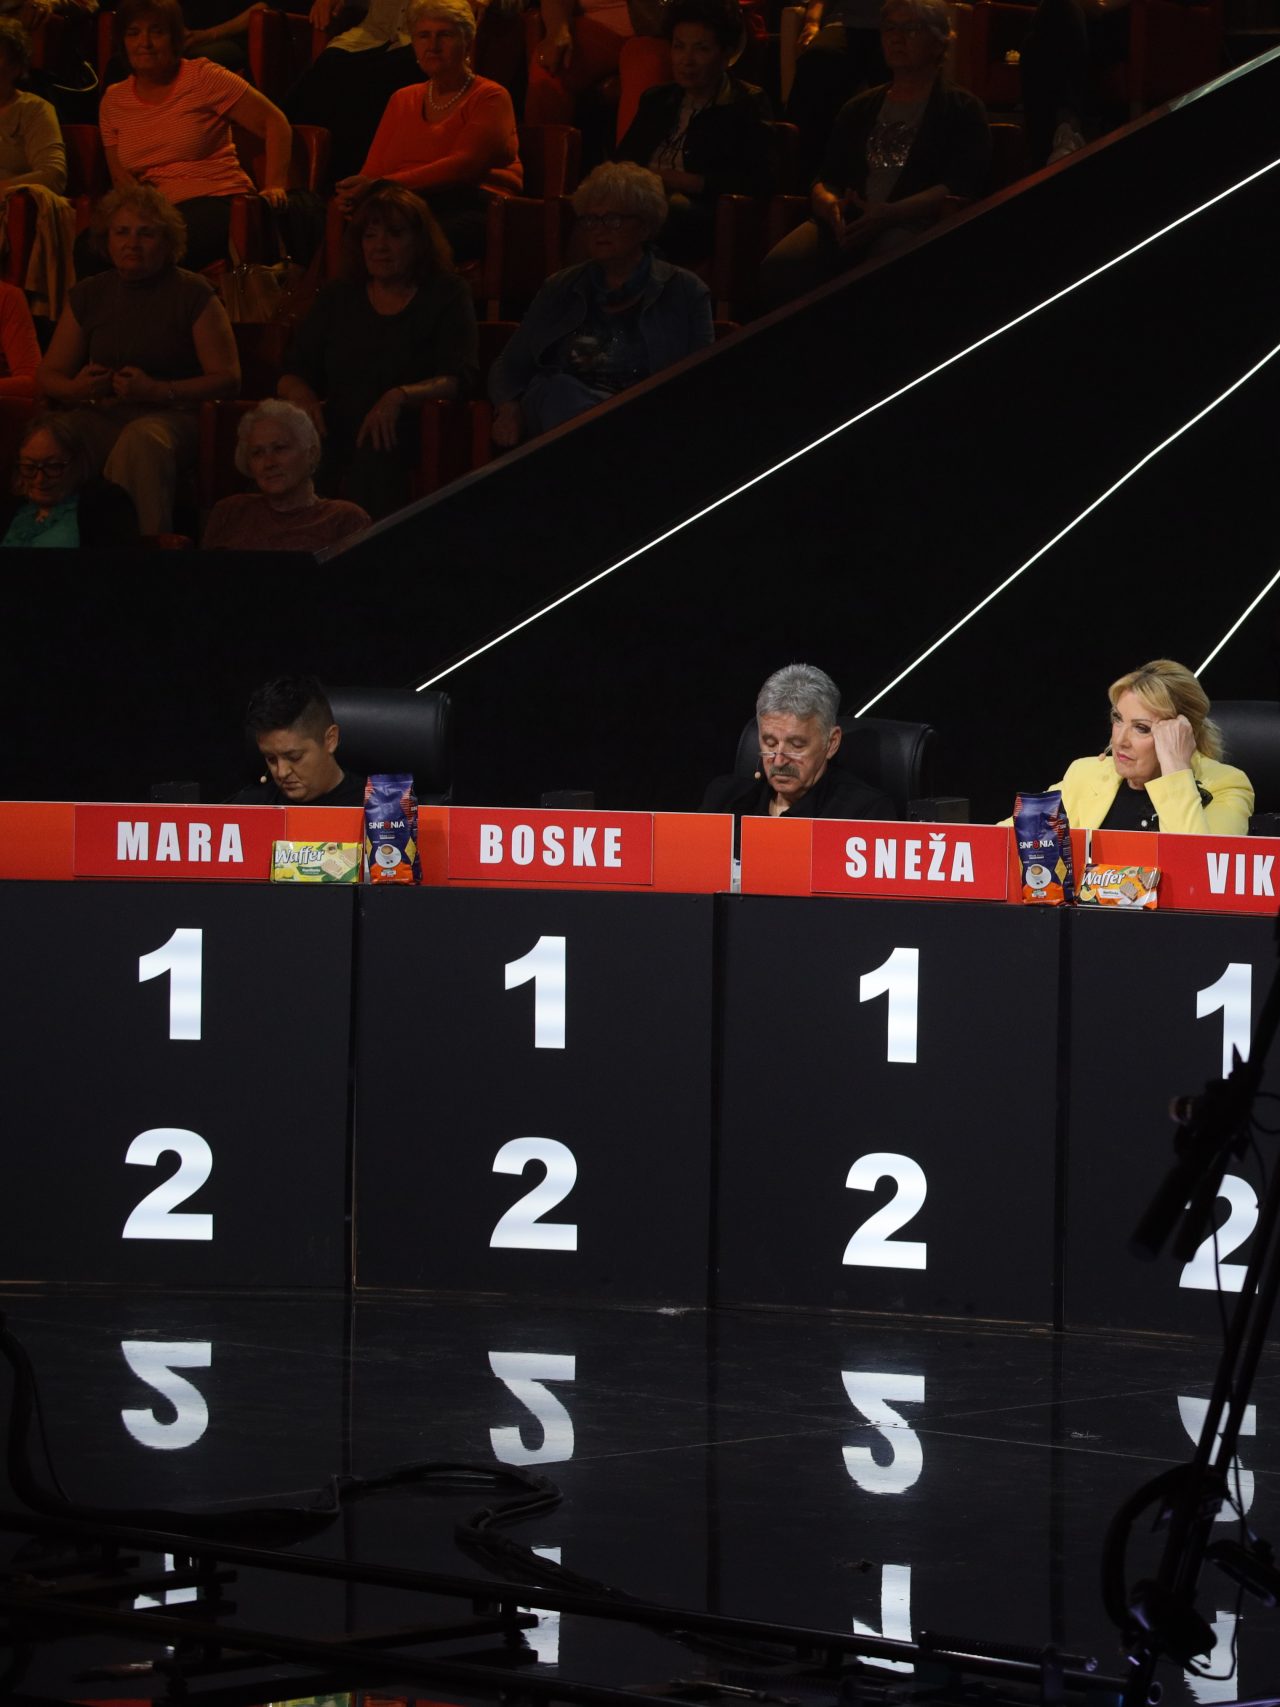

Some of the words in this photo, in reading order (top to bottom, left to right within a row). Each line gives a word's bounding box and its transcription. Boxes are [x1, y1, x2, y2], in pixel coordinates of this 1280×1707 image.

[117, 821, 244, 863] MARA
[275, 846, 325, 865] Waffer
[368, 820, 405, 830] SINFONIA
[479, 824, 622, 868] BOSKE
[845, 832, 974, 883] SNEŽA
[1019, 839, 1054, 849] SINFONIA
[1081, 869, 1126, 887] Waffer
[138, 927, 203, 1041] 1
[504, 935, 567, 1050] 1
[859, 947, 920, 1064] 1
[1196, 962, 1253, 1080] 1
[121, 1127, 214, 1241] 2
[489, 1136, 578, 1251] 2
[841, 1152, 928, 1270] 2
[1178, 1174, 1260, 1293] 2
